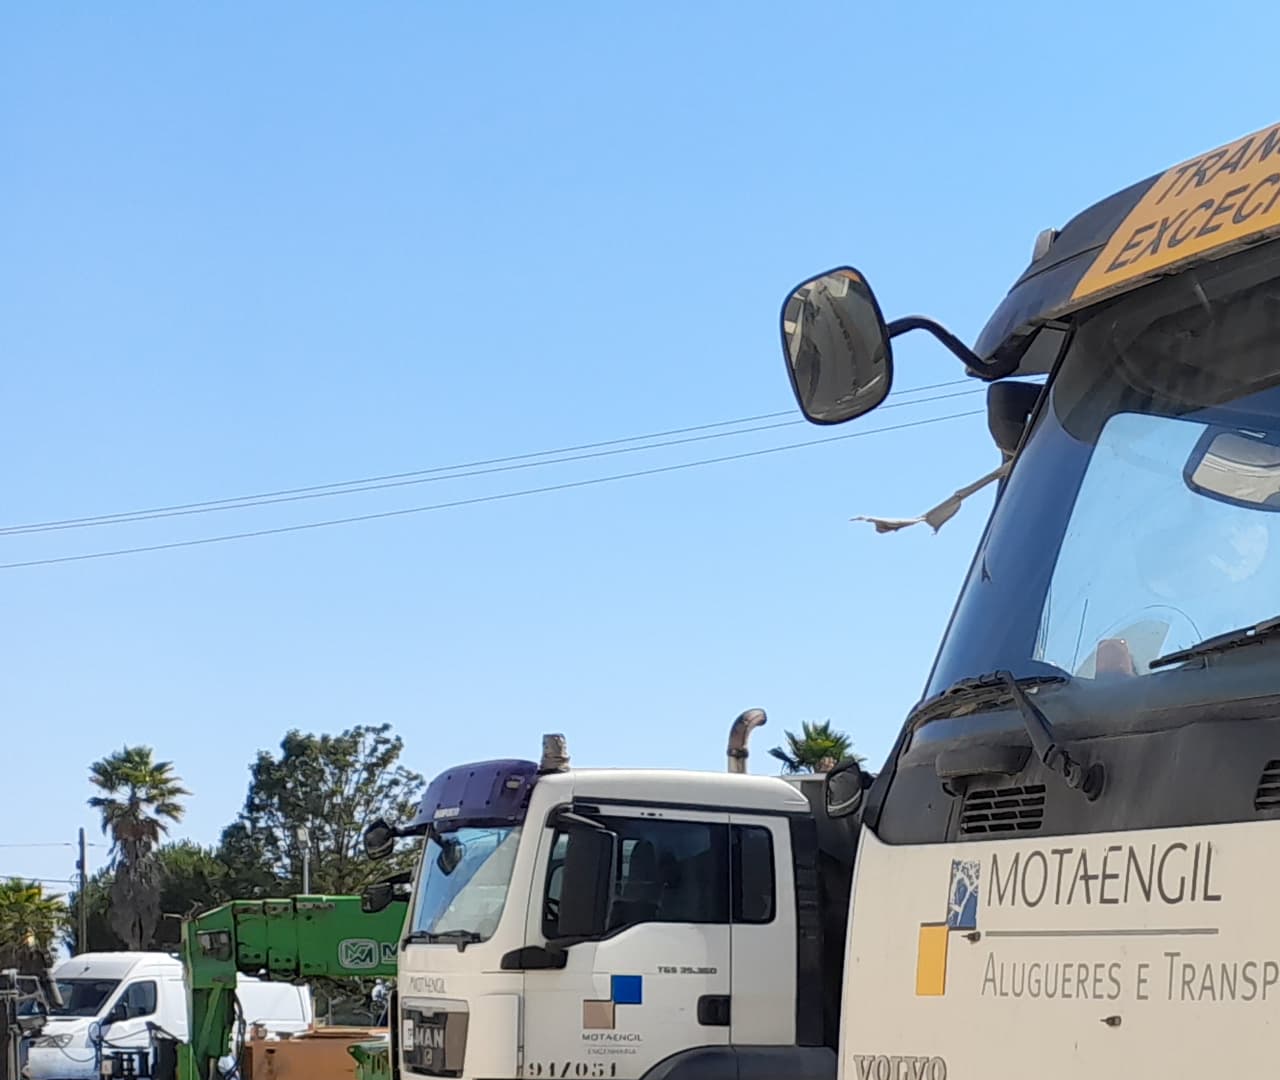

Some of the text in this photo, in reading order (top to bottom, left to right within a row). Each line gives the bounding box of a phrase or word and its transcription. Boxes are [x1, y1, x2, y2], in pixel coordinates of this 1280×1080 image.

[981, 951, 1122, 1001] ALUGUERES
[1136, 963, 1150, 1001] E
[415, 1025, 445, 1049] MAN
